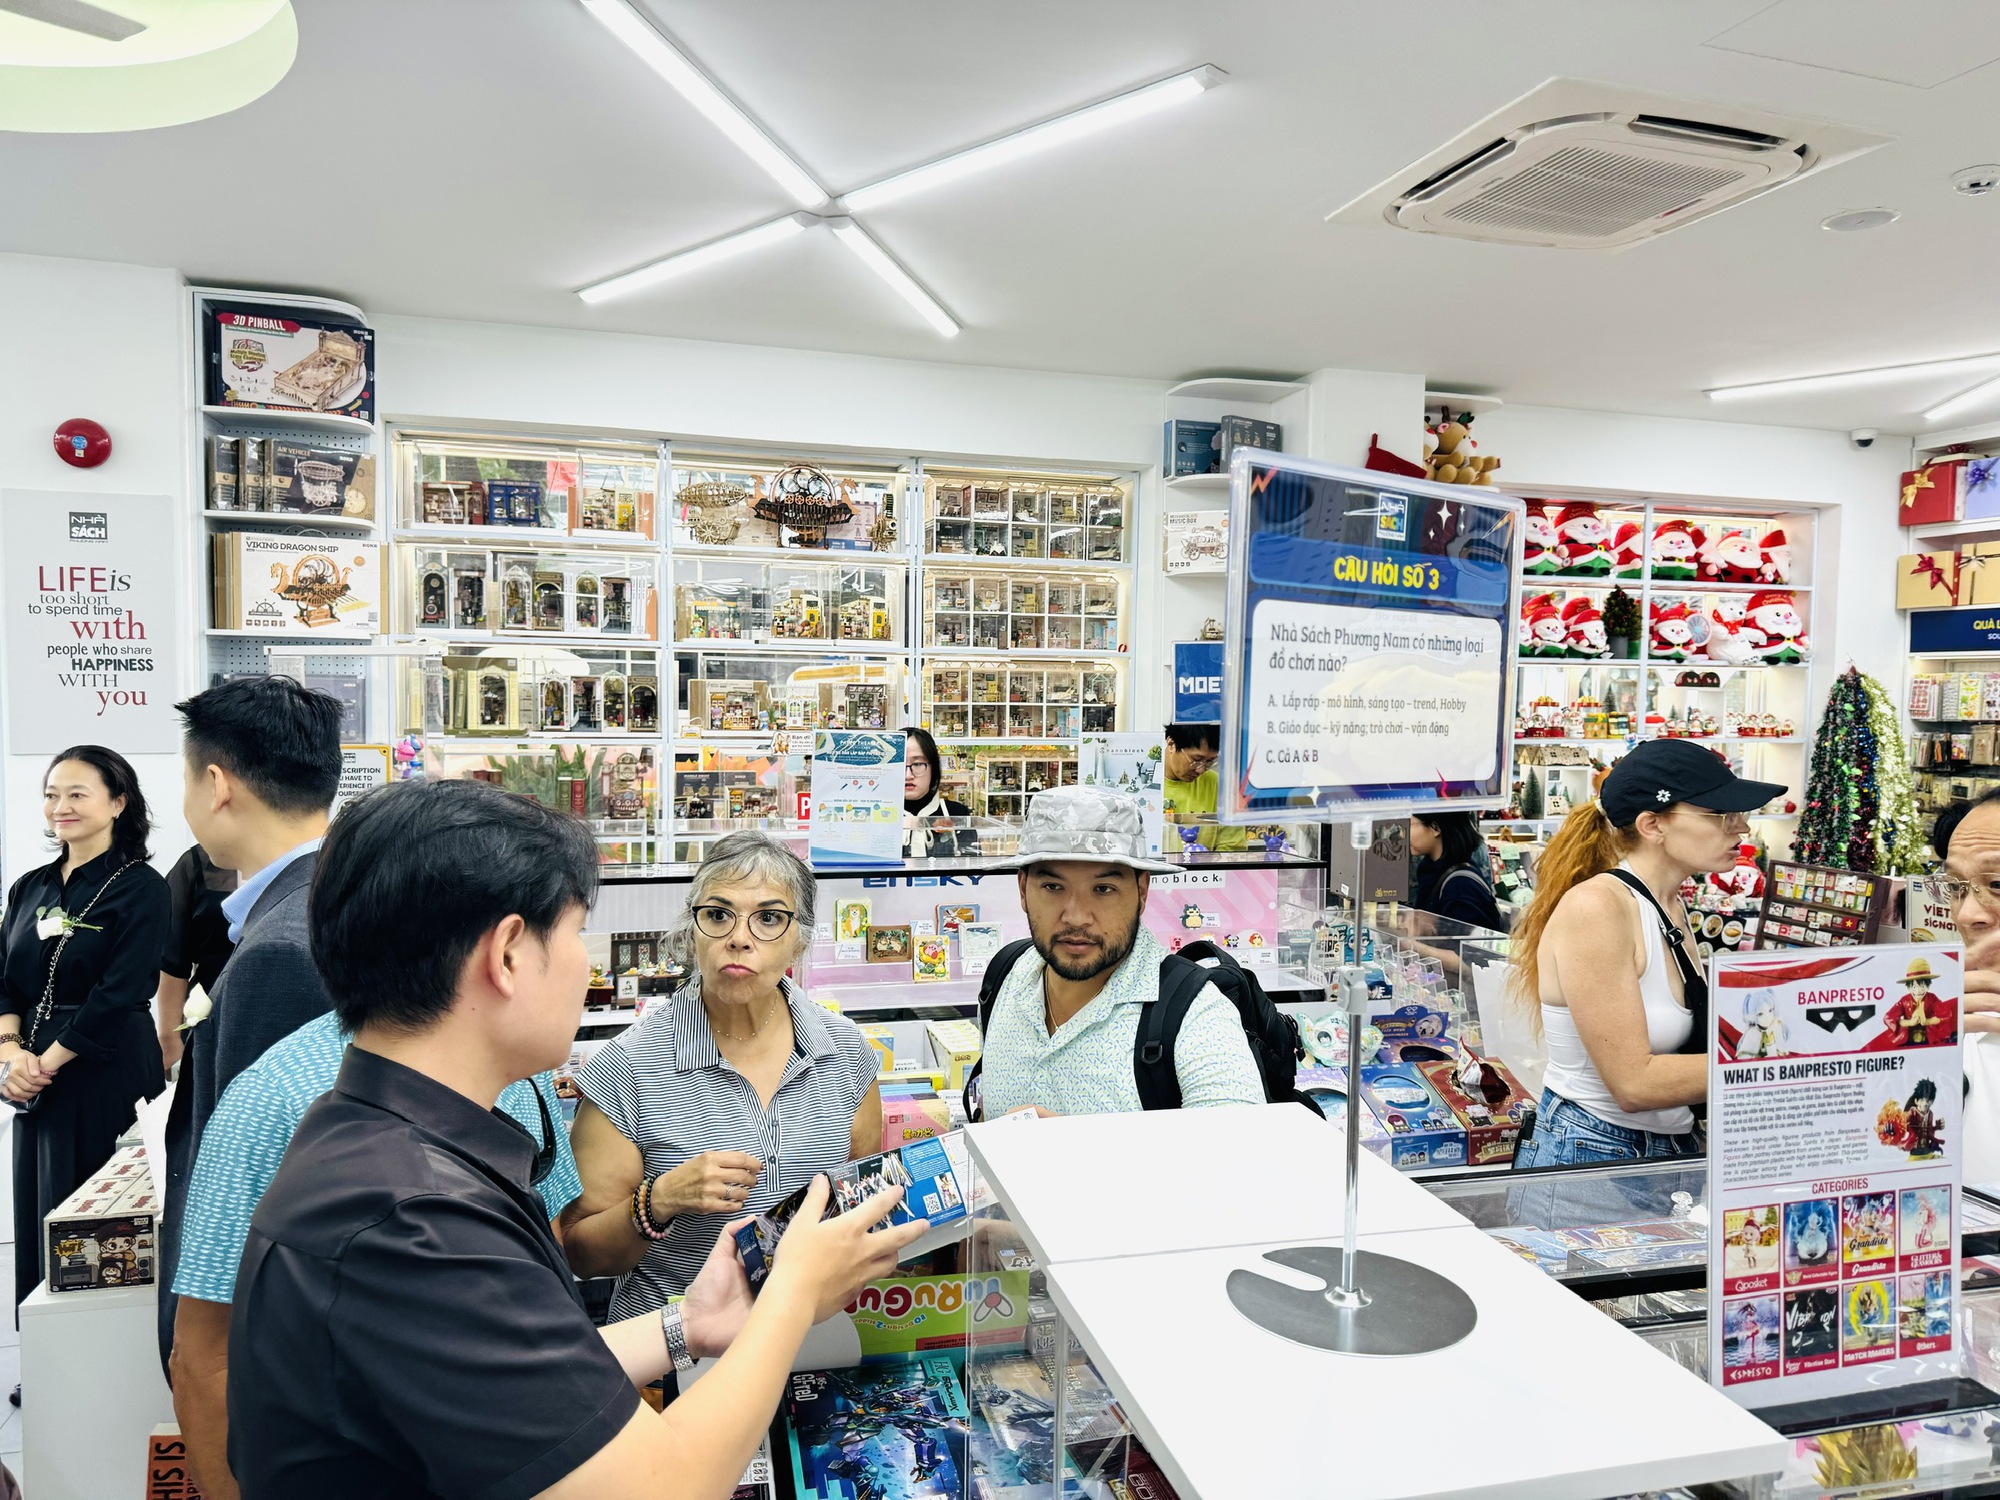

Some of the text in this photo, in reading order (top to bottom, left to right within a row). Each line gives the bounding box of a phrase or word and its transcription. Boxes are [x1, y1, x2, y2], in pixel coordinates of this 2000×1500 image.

[233, 315, 286, 331] 3D PINBALL
[288, 447, 310, 456] VEHICLE
[1381, 500, 1405, 514] NHÀ
[71, 514, 105, 524] NHÀ
[71, 525, 106, 538] SÁCH
[246, 541, 279, 550] VIKING
[280, 543, 318, 552] DRAGON
[318, 545, 339, 553] SHIP
[39, 565, 131, 592] LIFE is
[1333, 554, 1440, 590] CÂU HỎI SỐ 3
[40, 591, 109, 605] too short
[28, 604, 123, 617] to spend time
[70, 610, 147, 640] with
[1973, 618, 1995, 630] QUÀ
[1270, 623, 1484, 657] Nhà Sách Phương Nam có những loại
[47, 643, 152, 658] people who share
[71, 658, 154, 671] HAPPINESS
[1269, 646, 1347, 672] đồ chơi nào?
[58, 673, 118, 687] WITH
[1178, 675, 1224, 695] MOE
[96, 690, 148, 716] you
[1268, 694, 1277, 707] A.
[1283, 691, 1301, 711] Lắp
[1302, 696, 1320, 711] ráp
[1327, 696, 1341, 708] mô
[1343, 695, 1366, 710] hình,
[1368, 696, 1389, 712] sáng
[1391, 699, 1405, 712] tạo
[1413, 698, 1439, 711] trend,
[1440, 698, 1466, 713] Hobby
[1267, 721, 1276, 734] B.
[1279, 720, 1301, 734] Giáo
[1303, 721, 1320, 737] dục
[1330, 721, 1341, 737] kỹ
[1343, 722, 1368, 737] năng;
[1370, 722, 1383, 734] trò
[1385, 721, 1403, 734] chơi
[1411, 722, 1428, 737] vận
[1429, 721, 1449, 736] động
[1266, 749, 1319, 763] C. Cả A & B
[1151, 874, 1219, 884] noblock
[1798, 986, 1885, 1006] BANPRESTO
[1724, 1056, 1905, 1084] WHAT IS BANPRESTO FIGURE?
[902, 1127, 936, 1140] 星のカービィ
[1812, 1178, 1868, 1195] CATEGORIES
[1849, 1237, 1888, 1252] Grandista
[1852, 1262, 1887, 1276] Grandista
[1916, 1342, 1936, 1351] Others
[1844, 1347, 1895, 1362] MATCH MAKERS
[933, 1360, 952, 1375] HG
[1804, 1360, 1823, 1369] Vibration
[152, 1441, 186, 1500] HIS IS
